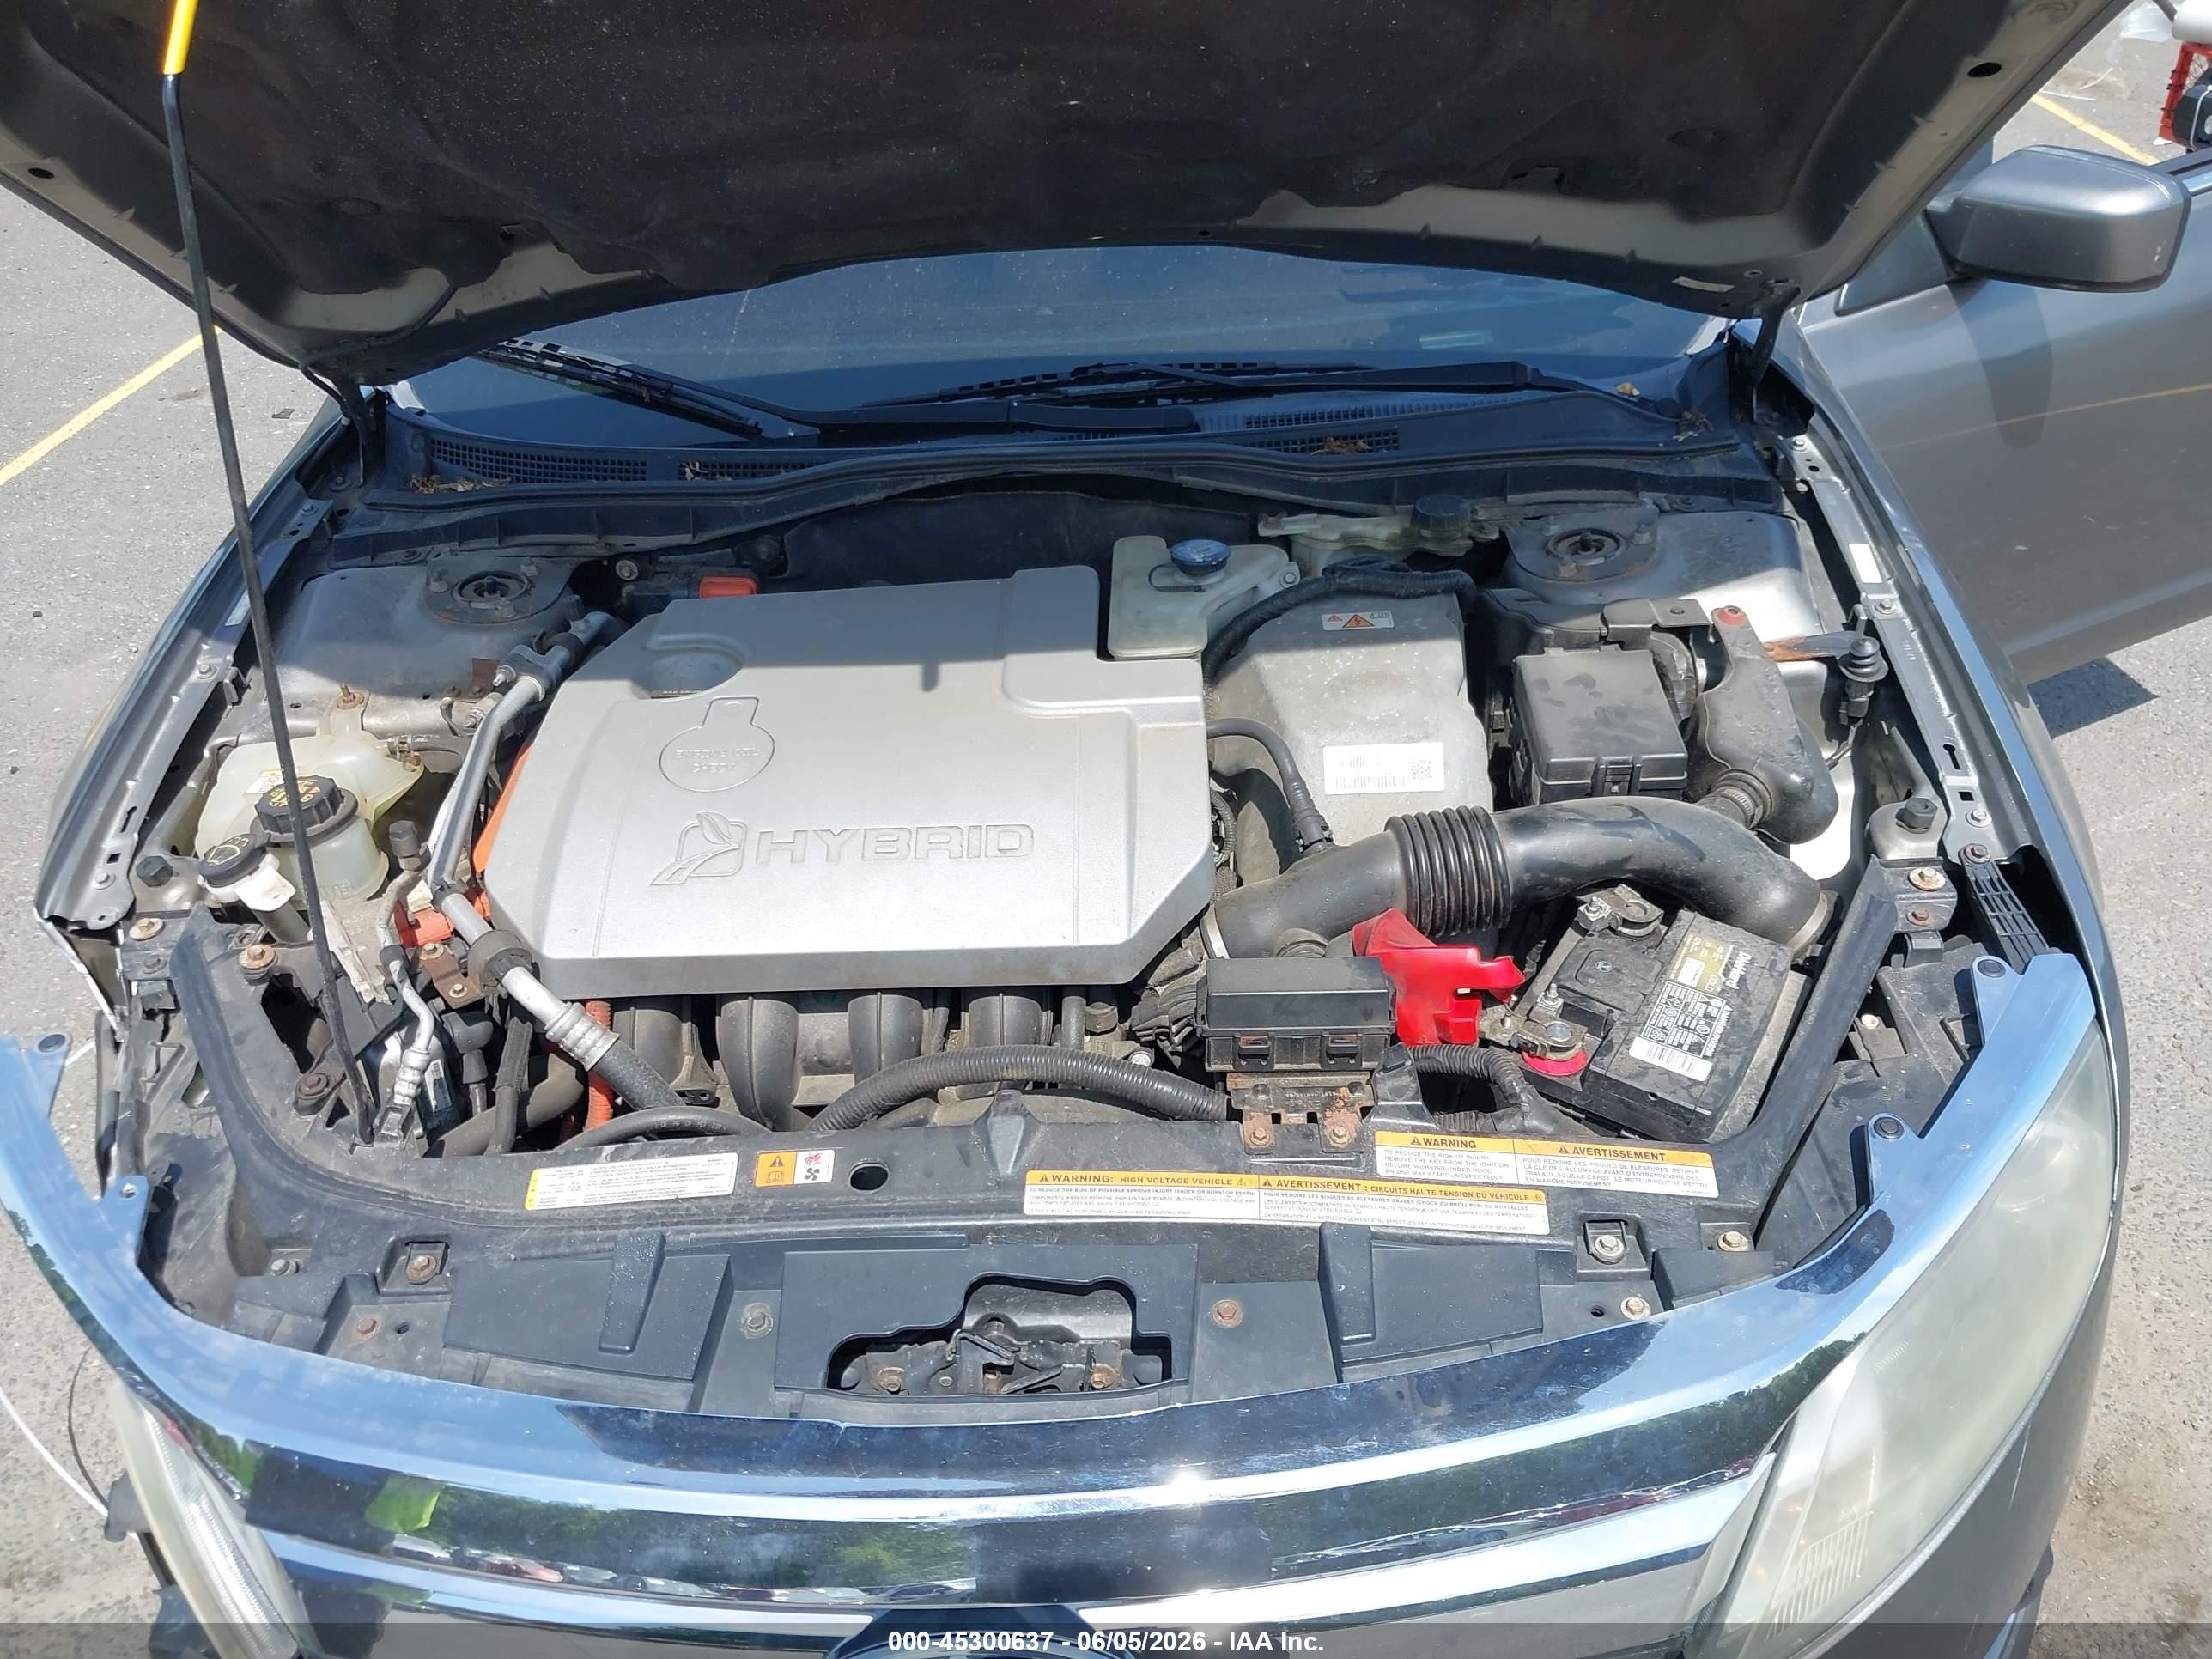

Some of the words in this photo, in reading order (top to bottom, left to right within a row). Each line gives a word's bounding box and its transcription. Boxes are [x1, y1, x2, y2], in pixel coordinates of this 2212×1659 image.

[756, 823, 1034, 866] HYBRID
[1725, 951, 1752, 990] DieHard
[1422, 1137, 1477, 1149] WARNING
[1572, 1146, 1666, 1161] AVERTISSEMENT
[1051, 1174, 1114, 1183] WARNING:
[1276, 1180, 1360, 1191] AVERTISSEMENT
